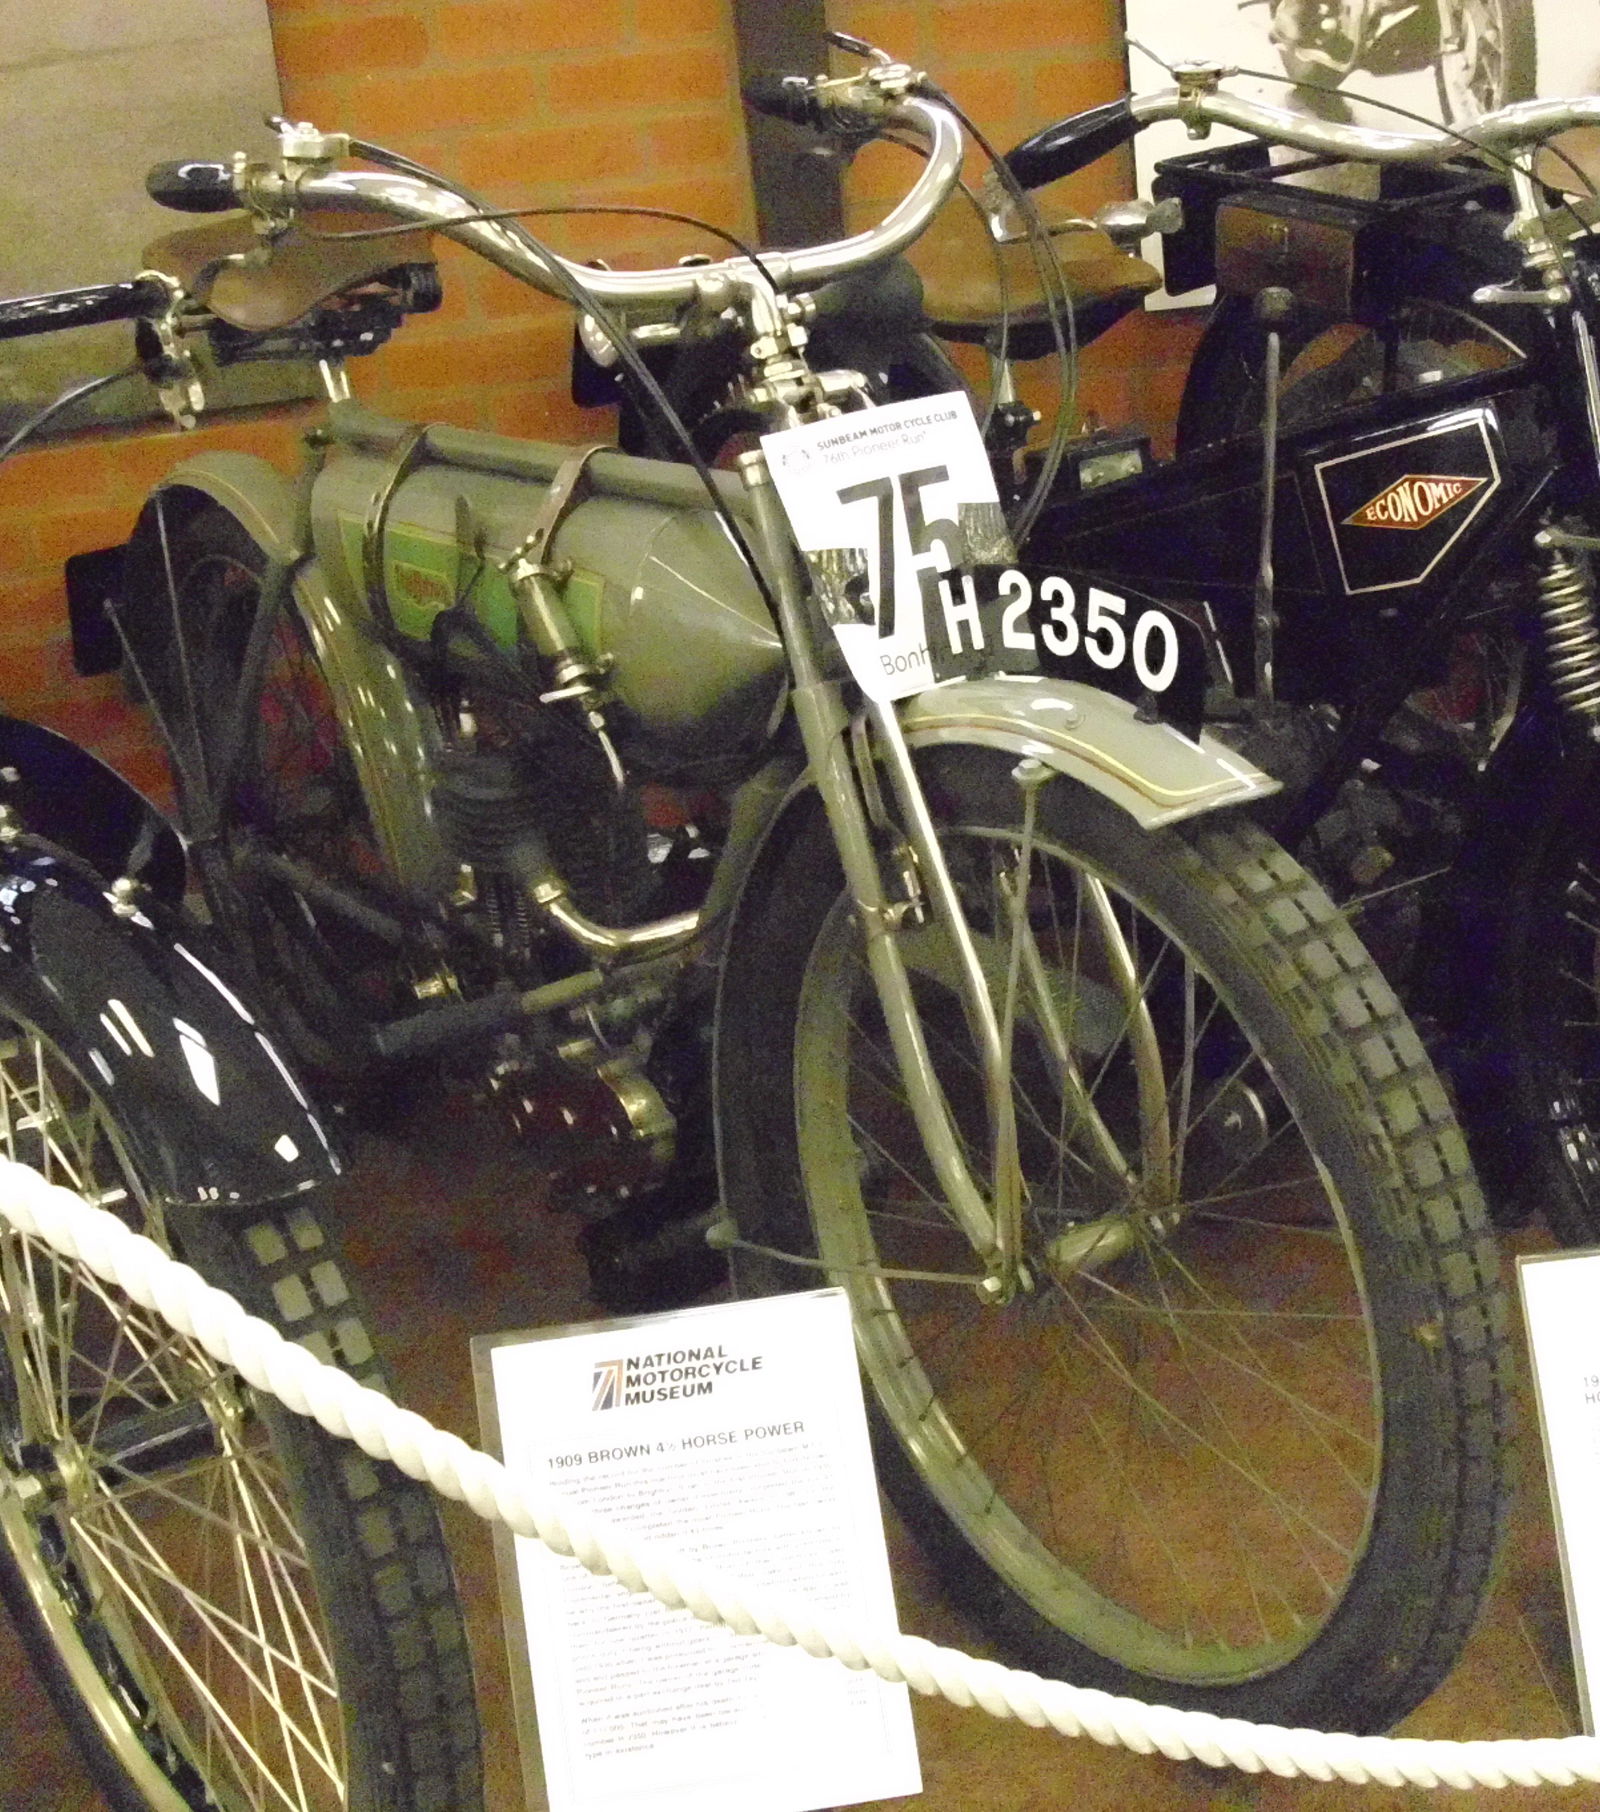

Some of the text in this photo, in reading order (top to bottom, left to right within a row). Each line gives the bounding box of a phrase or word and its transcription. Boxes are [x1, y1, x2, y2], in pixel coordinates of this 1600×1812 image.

[817, 410, 958, 451] SUNBEAM MOTOR CYCLE CLUB
[1365, 480, 1463, 523] ECONOMIC
[938, 569, 1179, 692] H 2350
[625, 1356, 764, 1388] MOTORCYCLE
[626, 1345, 729, 1371] NATIONAL
[625, 1381, 714, 1406] MUSEUM
[548, 1454, 583, 1469] 1909
[588, 1444, 651, 1464] BROWN
[681, 1430, 738, 1450] HORSE
[744, 1420, 806, 1441] POWER
